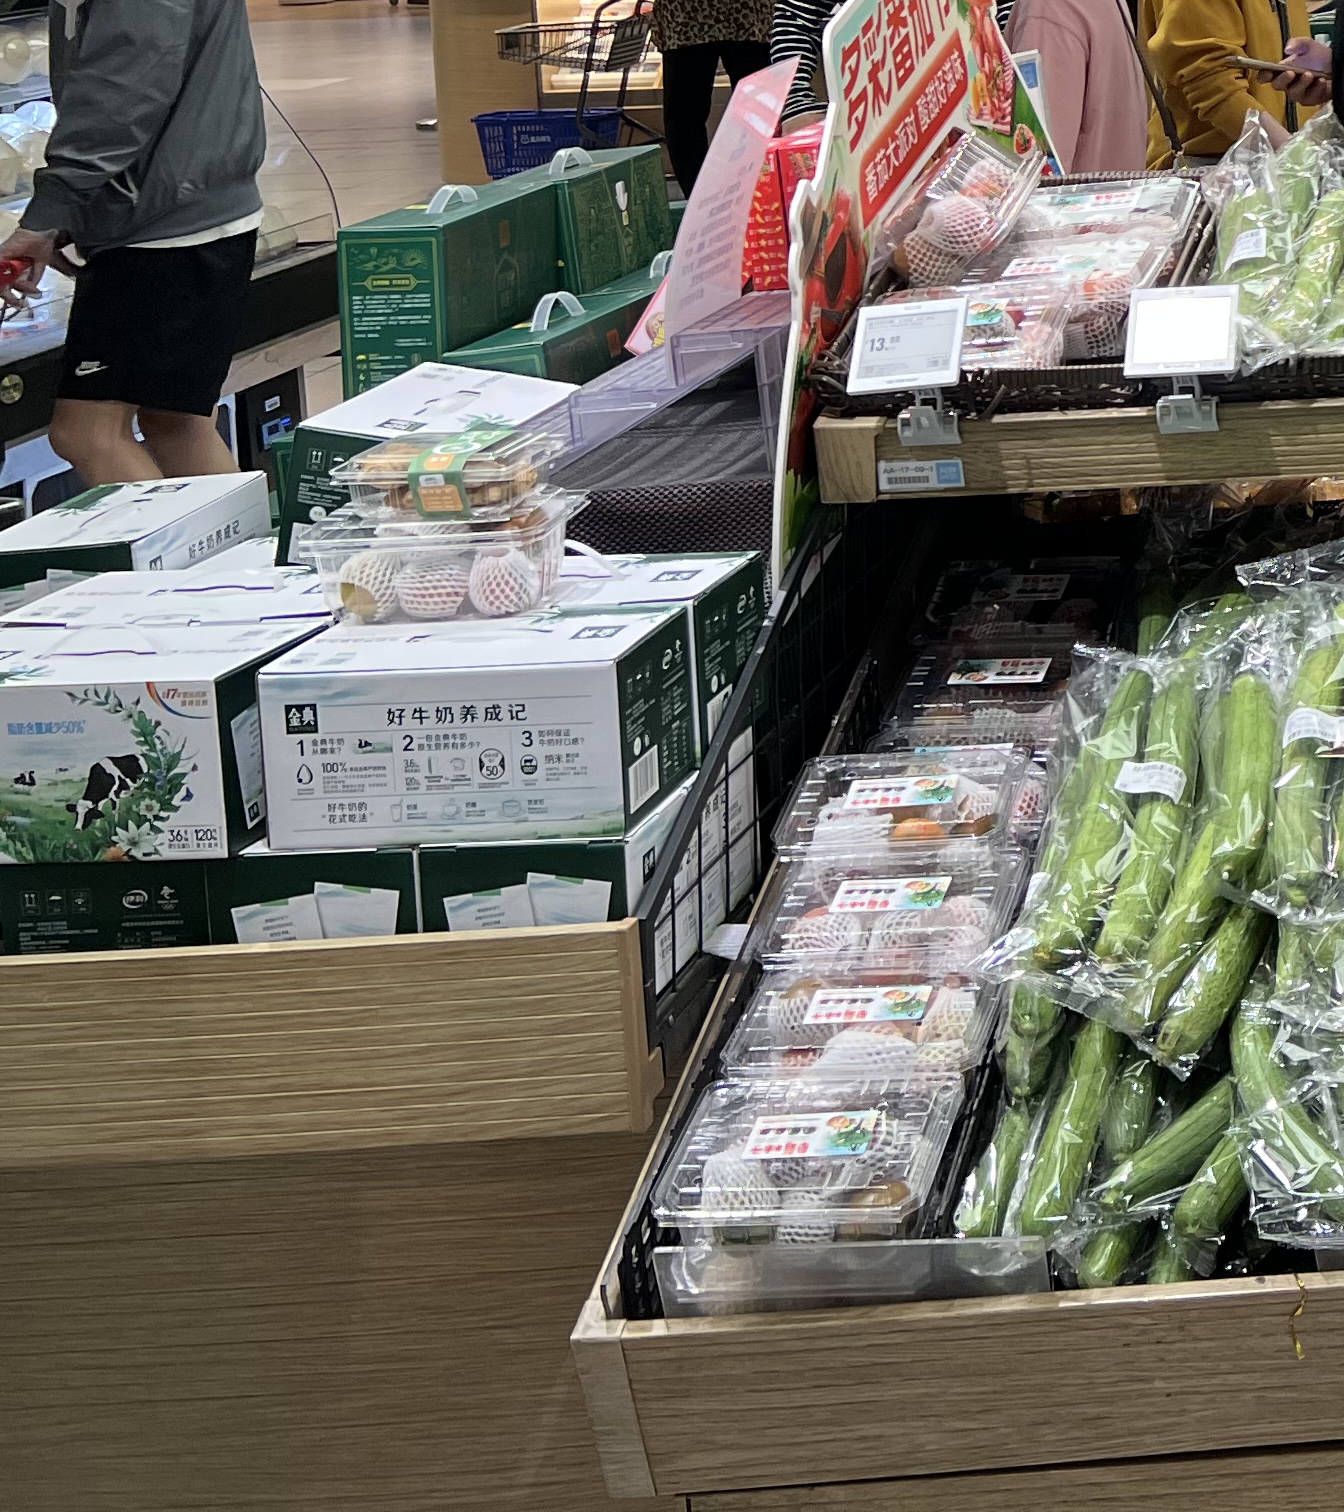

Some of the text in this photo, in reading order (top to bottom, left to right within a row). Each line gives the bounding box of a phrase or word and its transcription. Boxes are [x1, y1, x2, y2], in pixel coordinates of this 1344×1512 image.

[864, 48, 966, 204] 番茄大派对 酸甜好滋味
[188, 519, 241, 560] 好牛奶养成记
[287, 706, 316, 727] 金典
[387, 703, 528, 727] 好牛奶养成记
